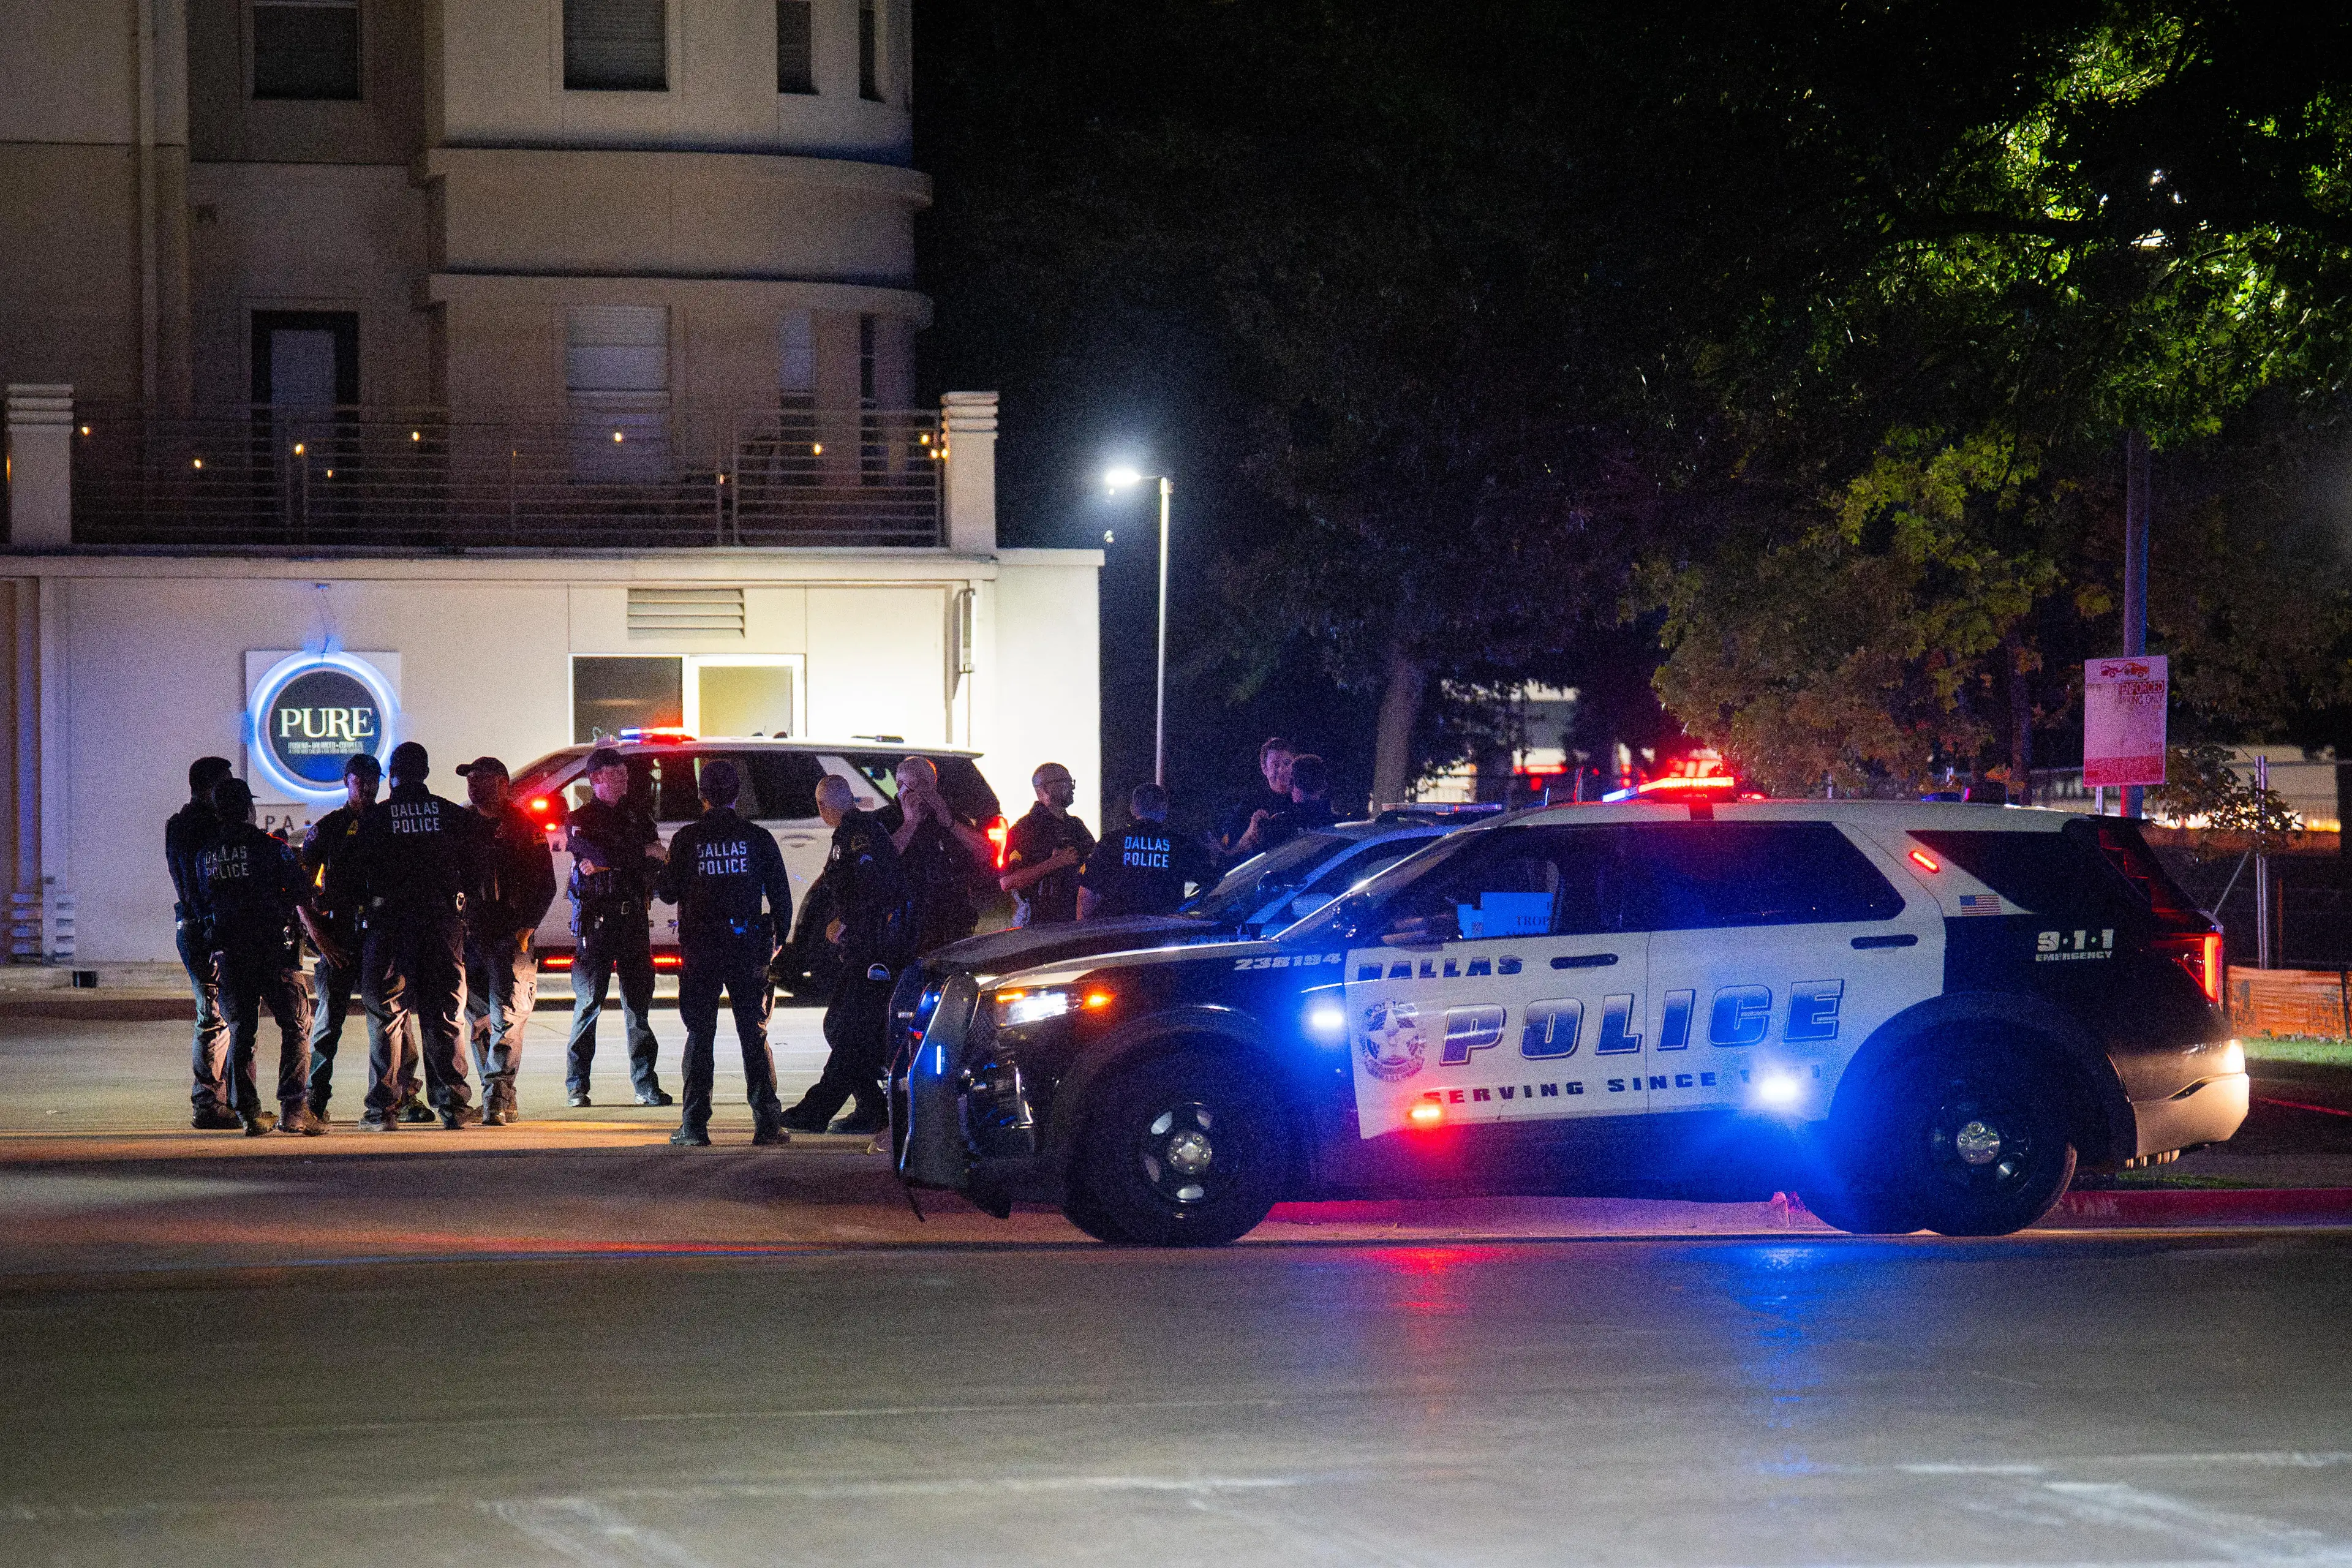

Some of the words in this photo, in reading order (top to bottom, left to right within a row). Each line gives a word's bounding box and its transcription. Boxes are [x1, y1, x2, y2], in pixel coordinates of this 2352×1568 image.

[279, 707, 374, 741] PURE
[390, 802, 439, 817] DALLAS
[392, 817, 441, 834] POLICE
[1125, 835, 1170, 851] DALLAS
[205, 845, 247, 864] DALLAS
[1123, 851, 1169, 868] POLICE
[206, 862, 249, 880] POLICE
[698, 858, 748, 875] POLICE
[1234, 952, 1342, 971] 238194
[2035, 951, 2112, 962] EMERGENCY
[1358, 955, 1522, 981] DALLAS
[1439, 978, 1845, 1066] POLICE
[1423, 1082, 1584, 1104] SERVING
[1608, 1072, 1716, 1093] SINCE
